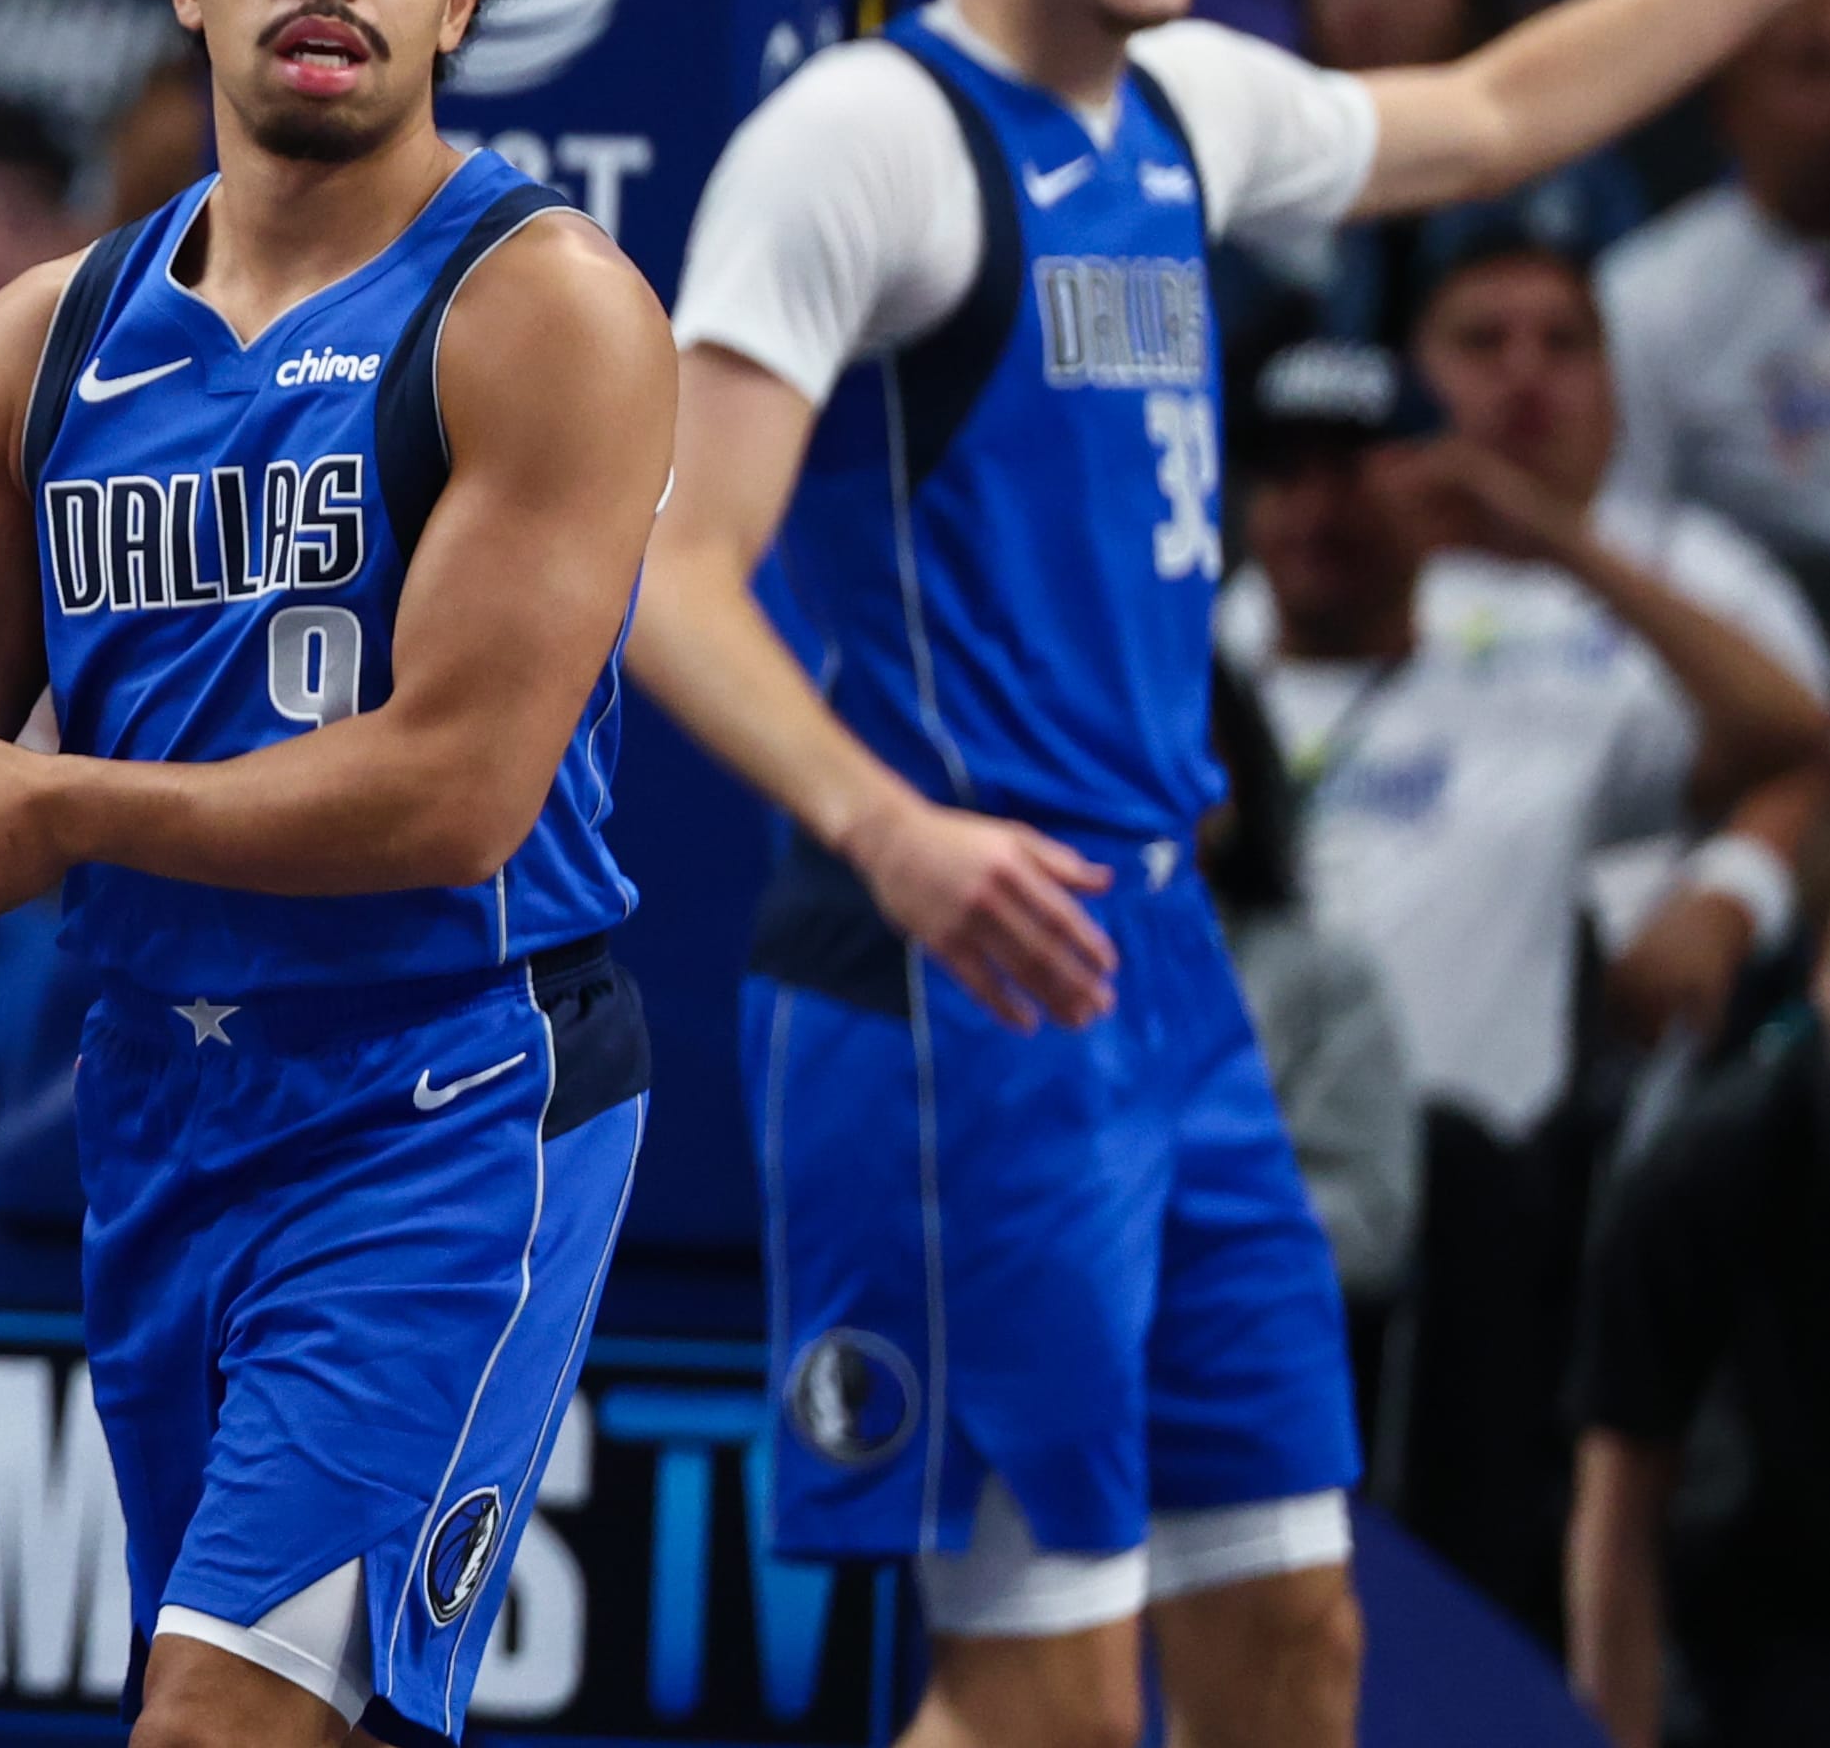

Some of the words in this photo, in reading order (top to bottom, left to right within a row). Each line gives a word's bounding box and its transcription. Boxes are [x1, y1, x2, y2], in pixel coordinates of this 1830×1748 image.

[275, 346, 381, 389] chime
[44, 453, 364, 616] DALLAS
[267, 605, 363, 728] 9
